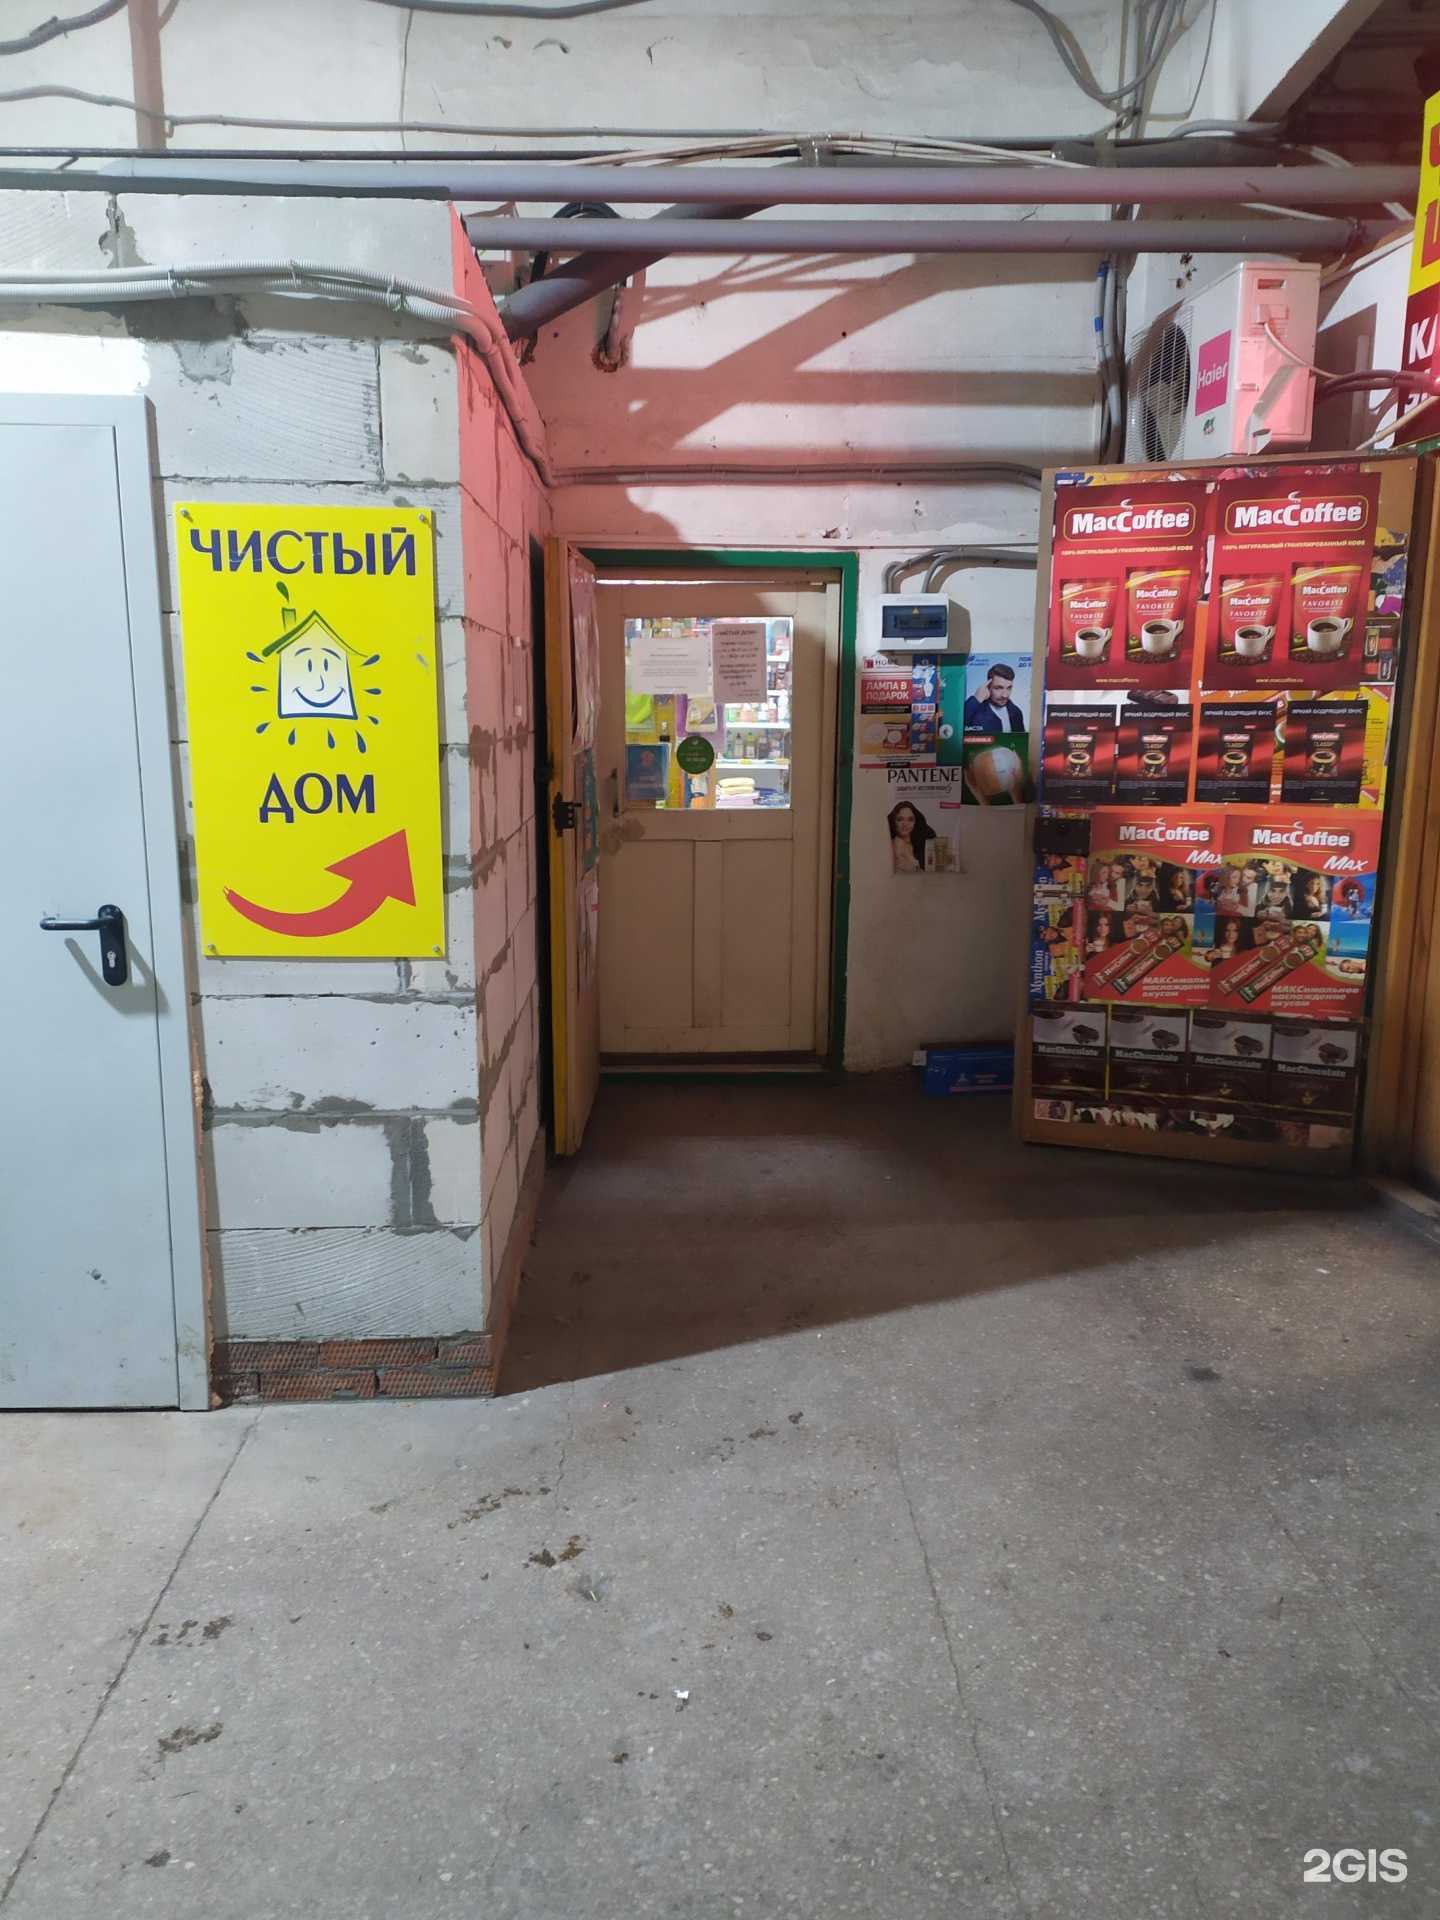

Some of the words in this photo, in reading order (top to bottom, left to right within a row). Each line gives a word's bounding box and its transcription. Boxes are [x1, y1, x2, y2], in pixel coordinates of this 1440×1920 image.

[1197, 360, 1228, 390] Haier
[1072, 509, 1190, 534] MacCoffee
[1234, 502, 1362, 528] MacCoffee
[190, 527, 416, 576] ЧИСТЫЙ
[1136, 588, 1178, 598] MacCoffee
[1302, 585, 1347, 595] MacCoffee
[866, 681, 898, 690] ЛАМПА
[900, 681, 908, 690] В
[866, 691, 909, 700] ПОДАРОК
[887, 768, 960, 783] PANTENE
[258, 772, 376, 824] ДОМ
[1119, 824, 1210, 842] MacCoffee
[1252, 829, 1350, 847] MacCoffee
[1030, 950, 1044, 994] Mynthon
[1271, 985, 1360, 994] МАКСимальное
[1276, 1063, 1346, 1078] MacChocolate
